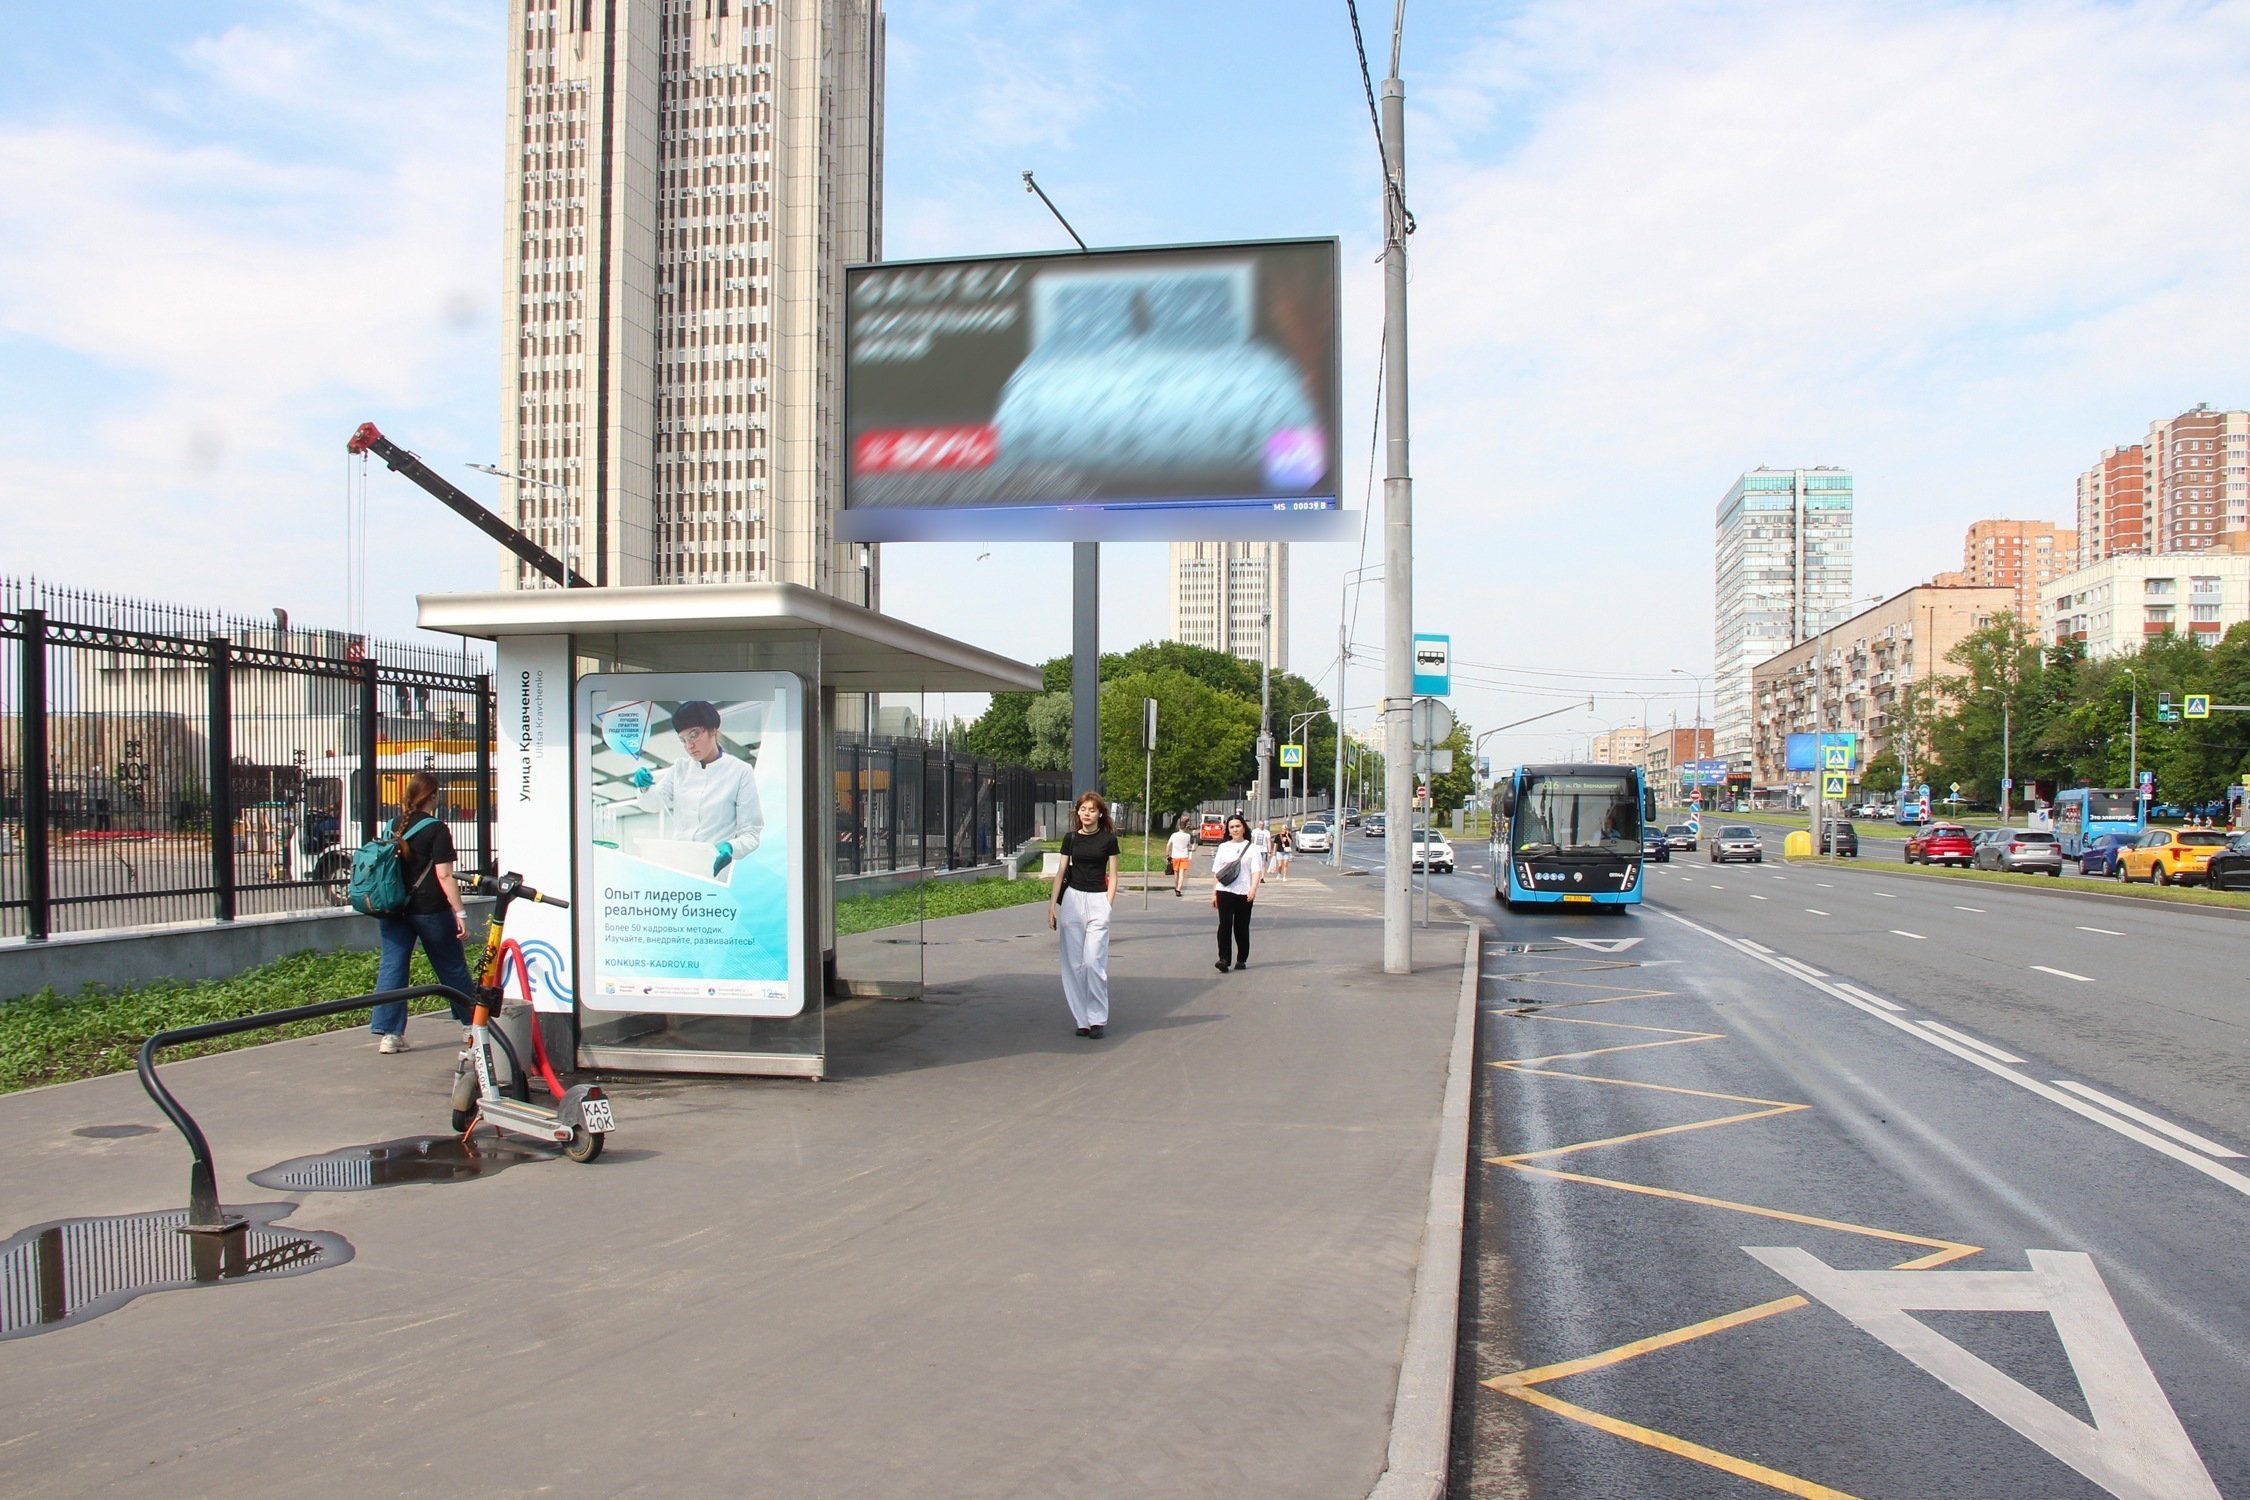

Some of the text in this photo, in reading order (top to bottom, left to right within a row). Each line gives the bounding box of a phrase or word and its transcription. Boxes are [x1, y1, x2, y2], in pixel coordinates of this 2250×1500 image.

[1273, 503, 1286, 511] MS
[535, 670, 544, 759] Ulitsa Kravchenko
[519, 670, 533, 802] Улица Кравченко
[1542, 781, 1559, 789] 616
[2102, 813, 2138, 821] электробус.
[604, 887, 641, 900] Опыт
[644, 890, 702, 904] лидеров
[604, 904, 737, 921] реальному бизнесу
[604, 923, 725, 934] Более 50 кадровых методик.
[604, 934, 756, 946] Изучайте, внедряйте, развивайтесь!
[604, 958, 700, 969] KONKURS-KADROV.RU
[583, 1102, 610, 1117] KA5
[588, 1116, 615, 1131] 40K
